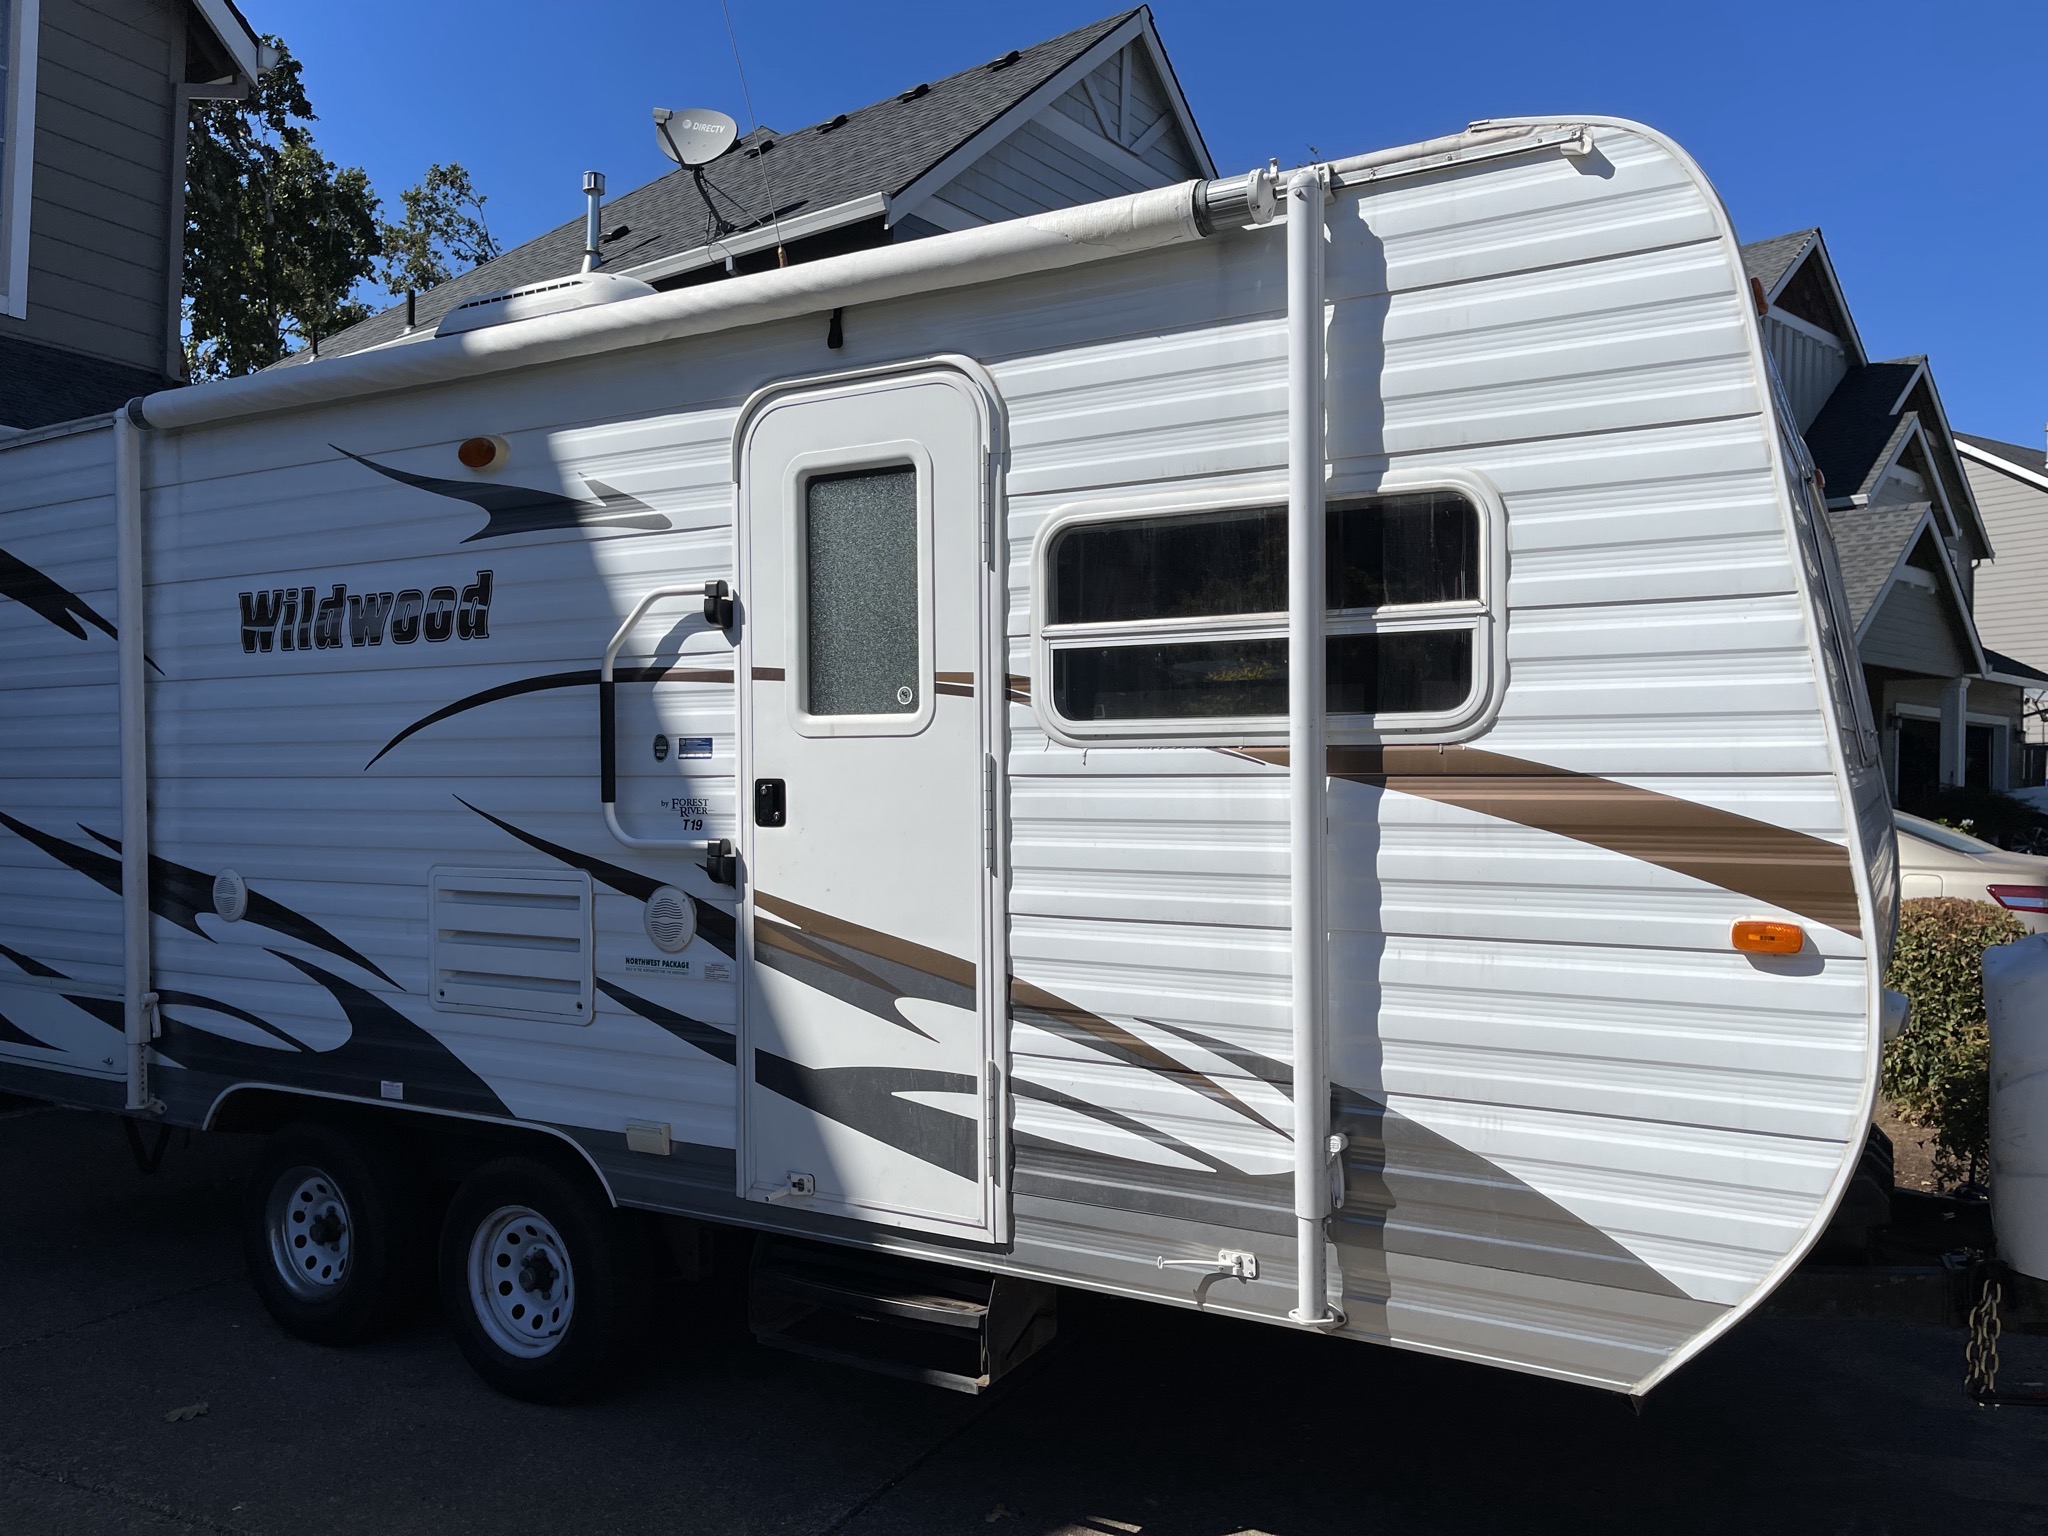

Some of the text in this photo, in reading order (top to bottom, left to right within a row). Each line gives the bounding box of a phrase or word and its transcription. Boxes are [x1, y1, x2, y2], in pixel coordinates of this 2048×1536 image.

[693, 122, 725, 133] DIRECTV
[239, 570, 494, 653] Wildwood
[660, 798, 709, 810] by FOREST
[680, 806, 708, 817] RIVER
[625, 957, 690, 969] NORTHWEST PACKAGE
